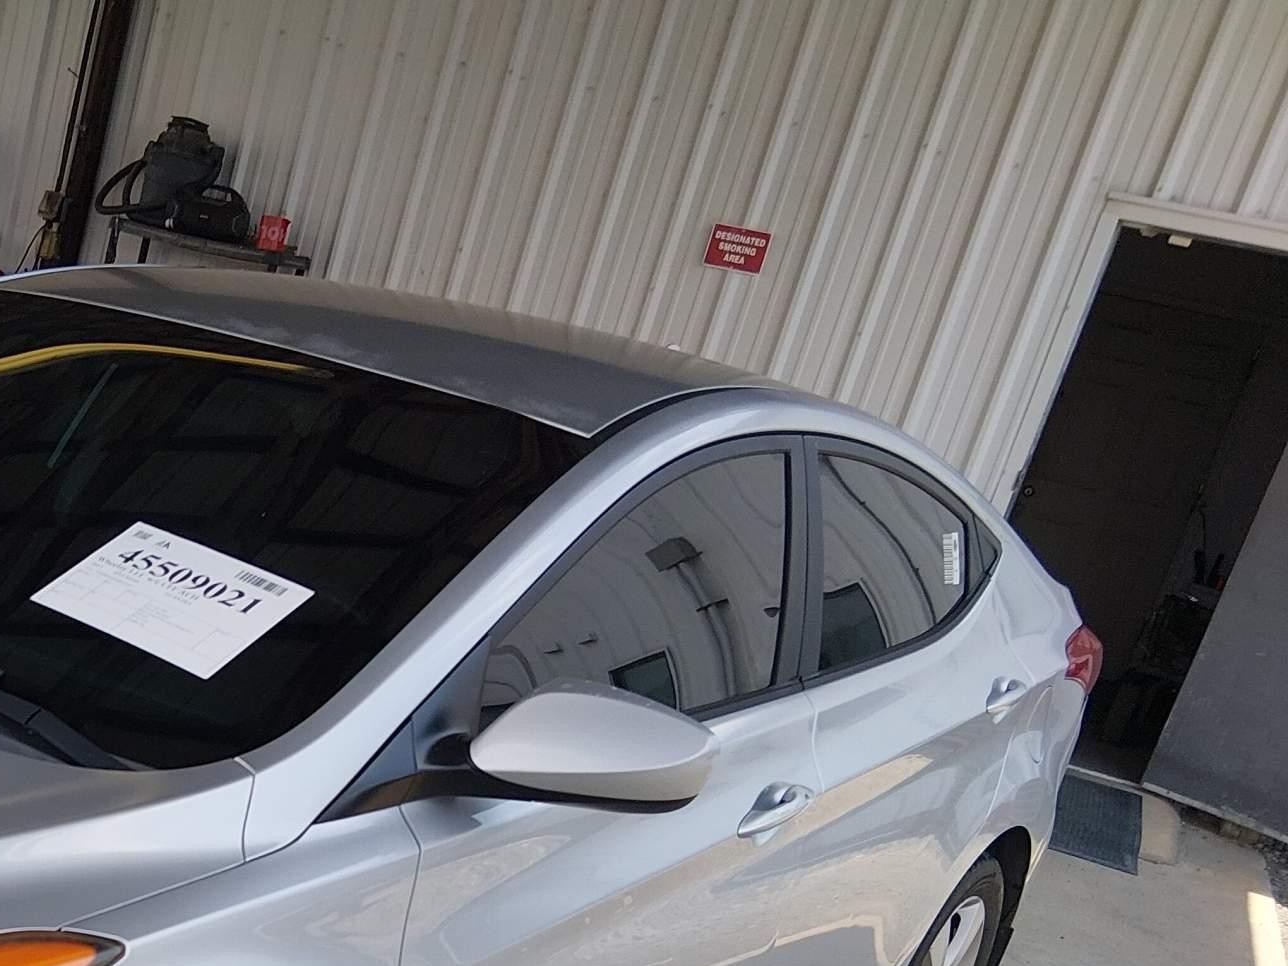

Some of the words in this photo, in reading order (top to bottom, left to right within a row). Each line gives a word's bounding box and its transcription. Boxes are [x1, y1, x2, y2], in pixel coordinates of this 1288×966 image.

[715, 231, 766, 247] DESIGNATED
[718, 242, 757, 256] SMOKING
[723, 253, 745, 264] AREA
[118, 549, 264, 614] 45509021
